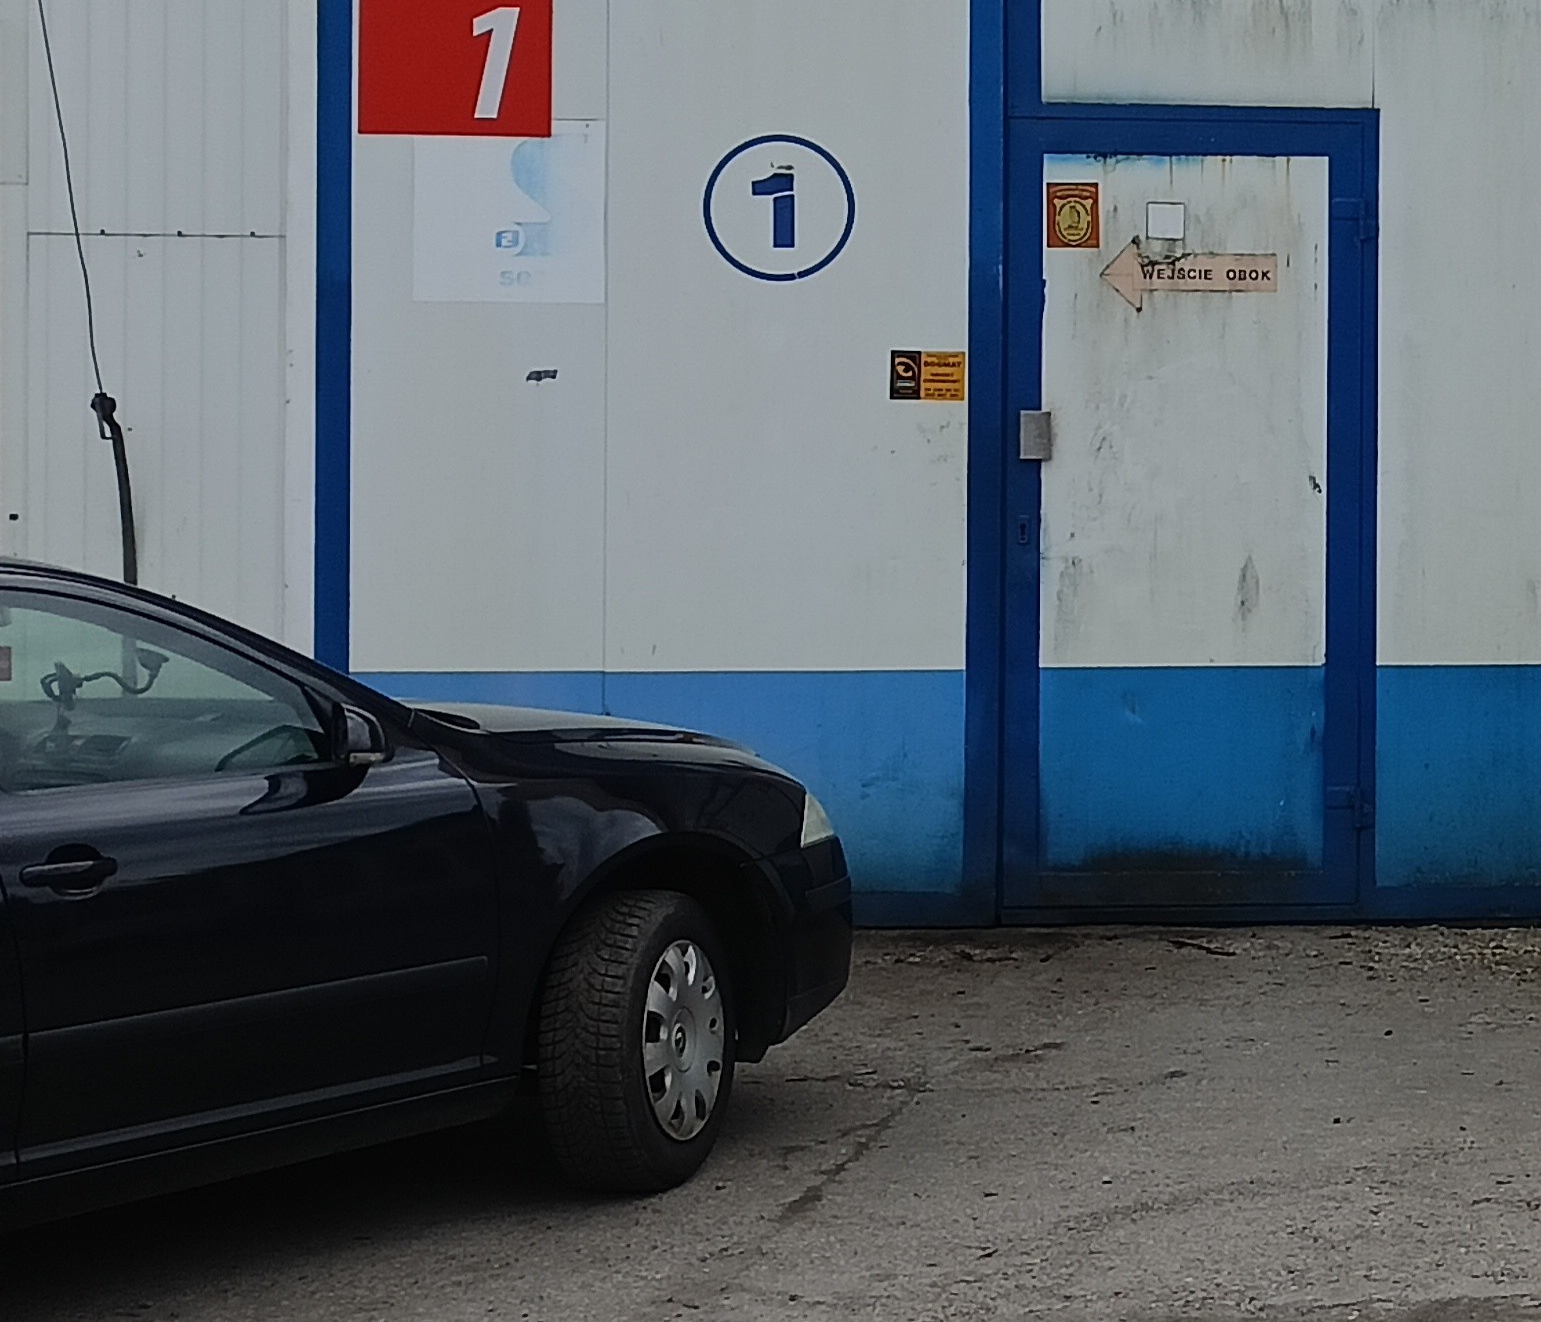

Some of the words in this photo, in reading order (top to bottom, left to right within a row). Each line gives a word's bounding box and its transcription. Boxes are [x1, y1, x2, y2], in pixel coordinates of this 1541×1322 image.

[471, 5, 522, 120] 1
[750, 167, 796, 249] 1
[1226, 268, 1271, 281] OBOK
